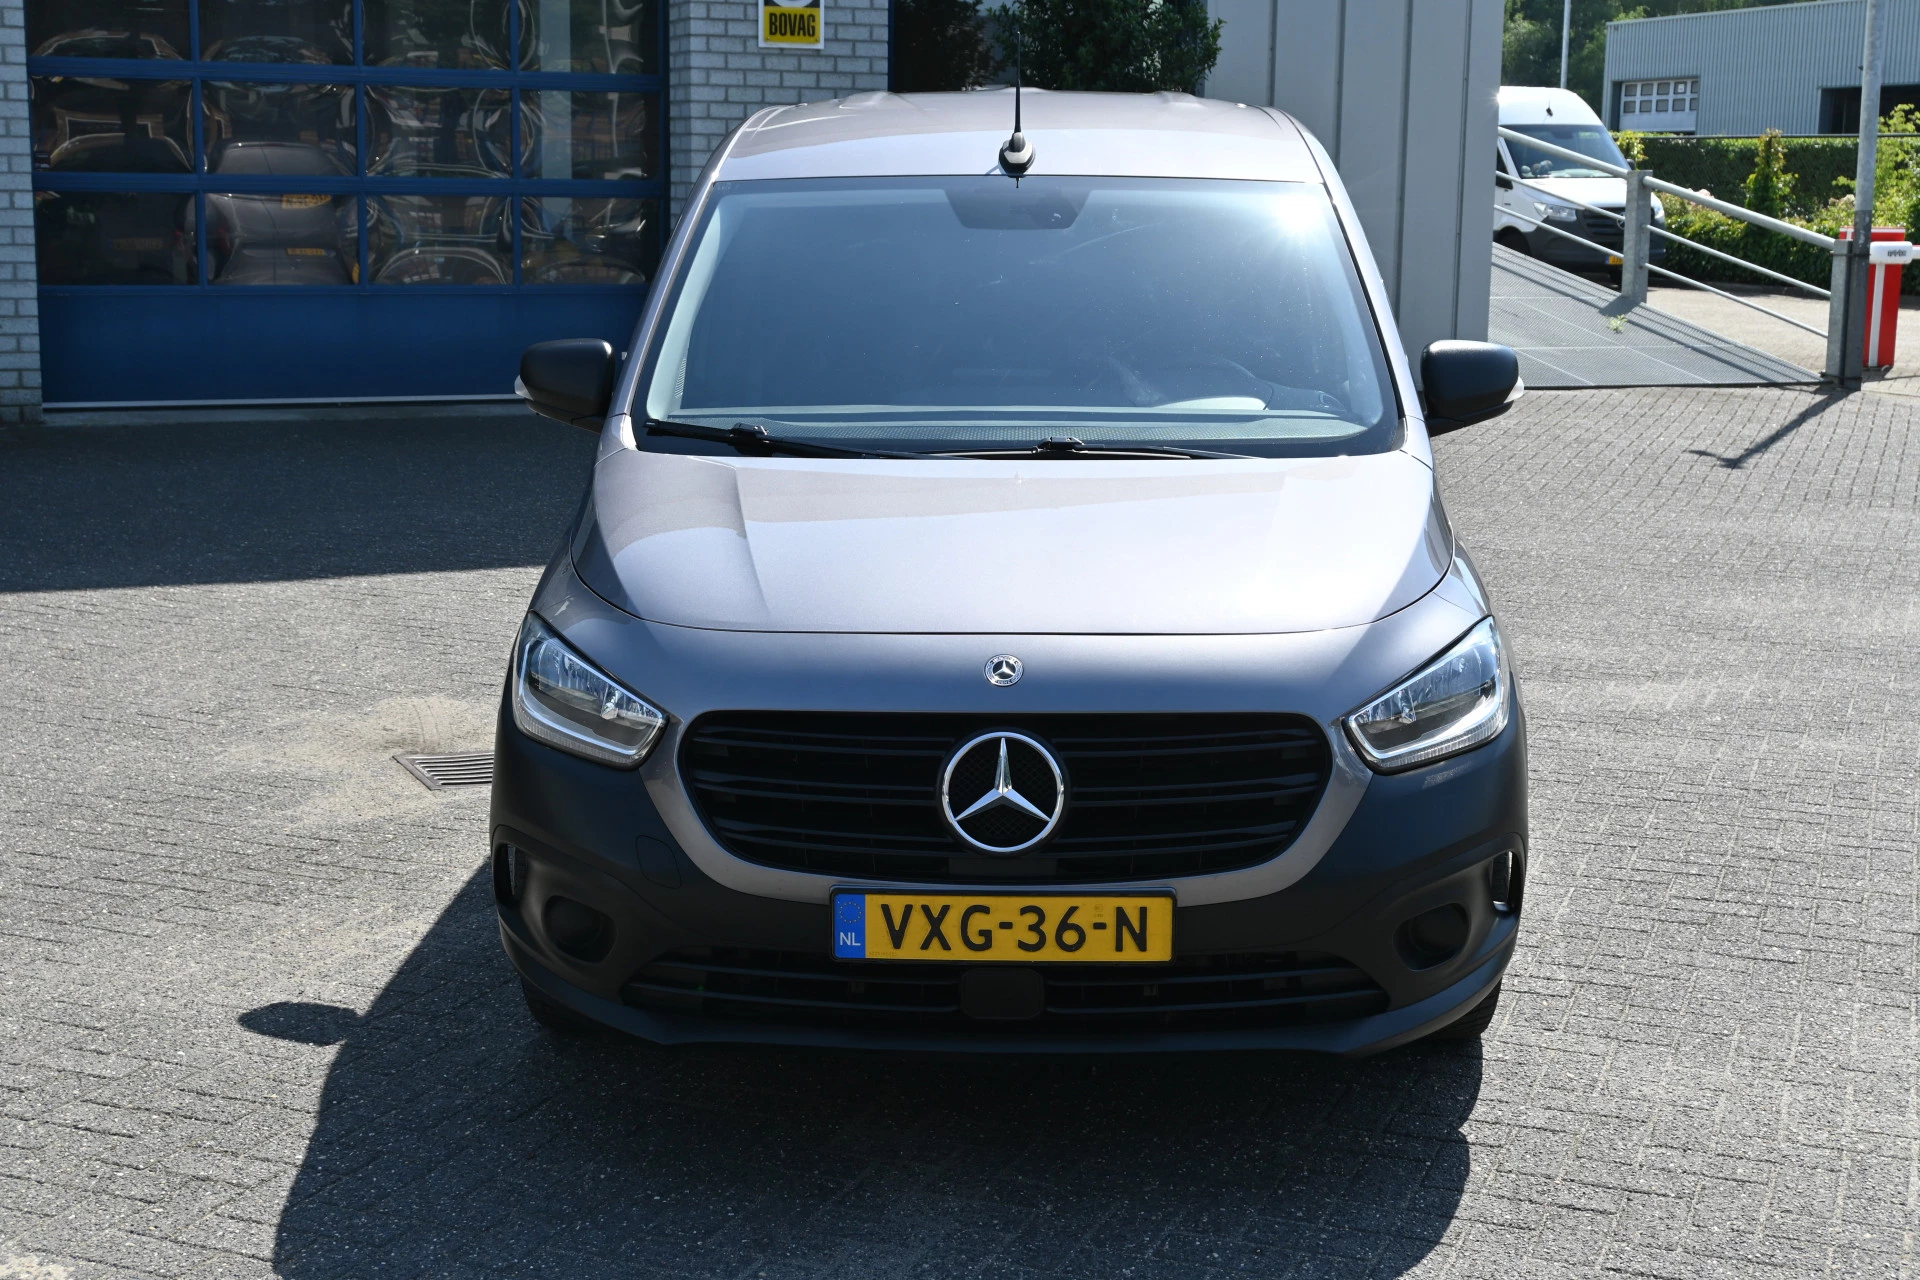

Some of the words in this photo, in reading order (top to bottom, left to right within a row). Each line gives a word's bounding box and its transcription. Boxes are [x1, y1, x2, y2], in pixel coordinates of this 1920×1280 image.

[769, 12, 816, 37] BOVAG
[839, 931, 861, 946] NL
[880, 903, 1148, 953] VXG-36-N
